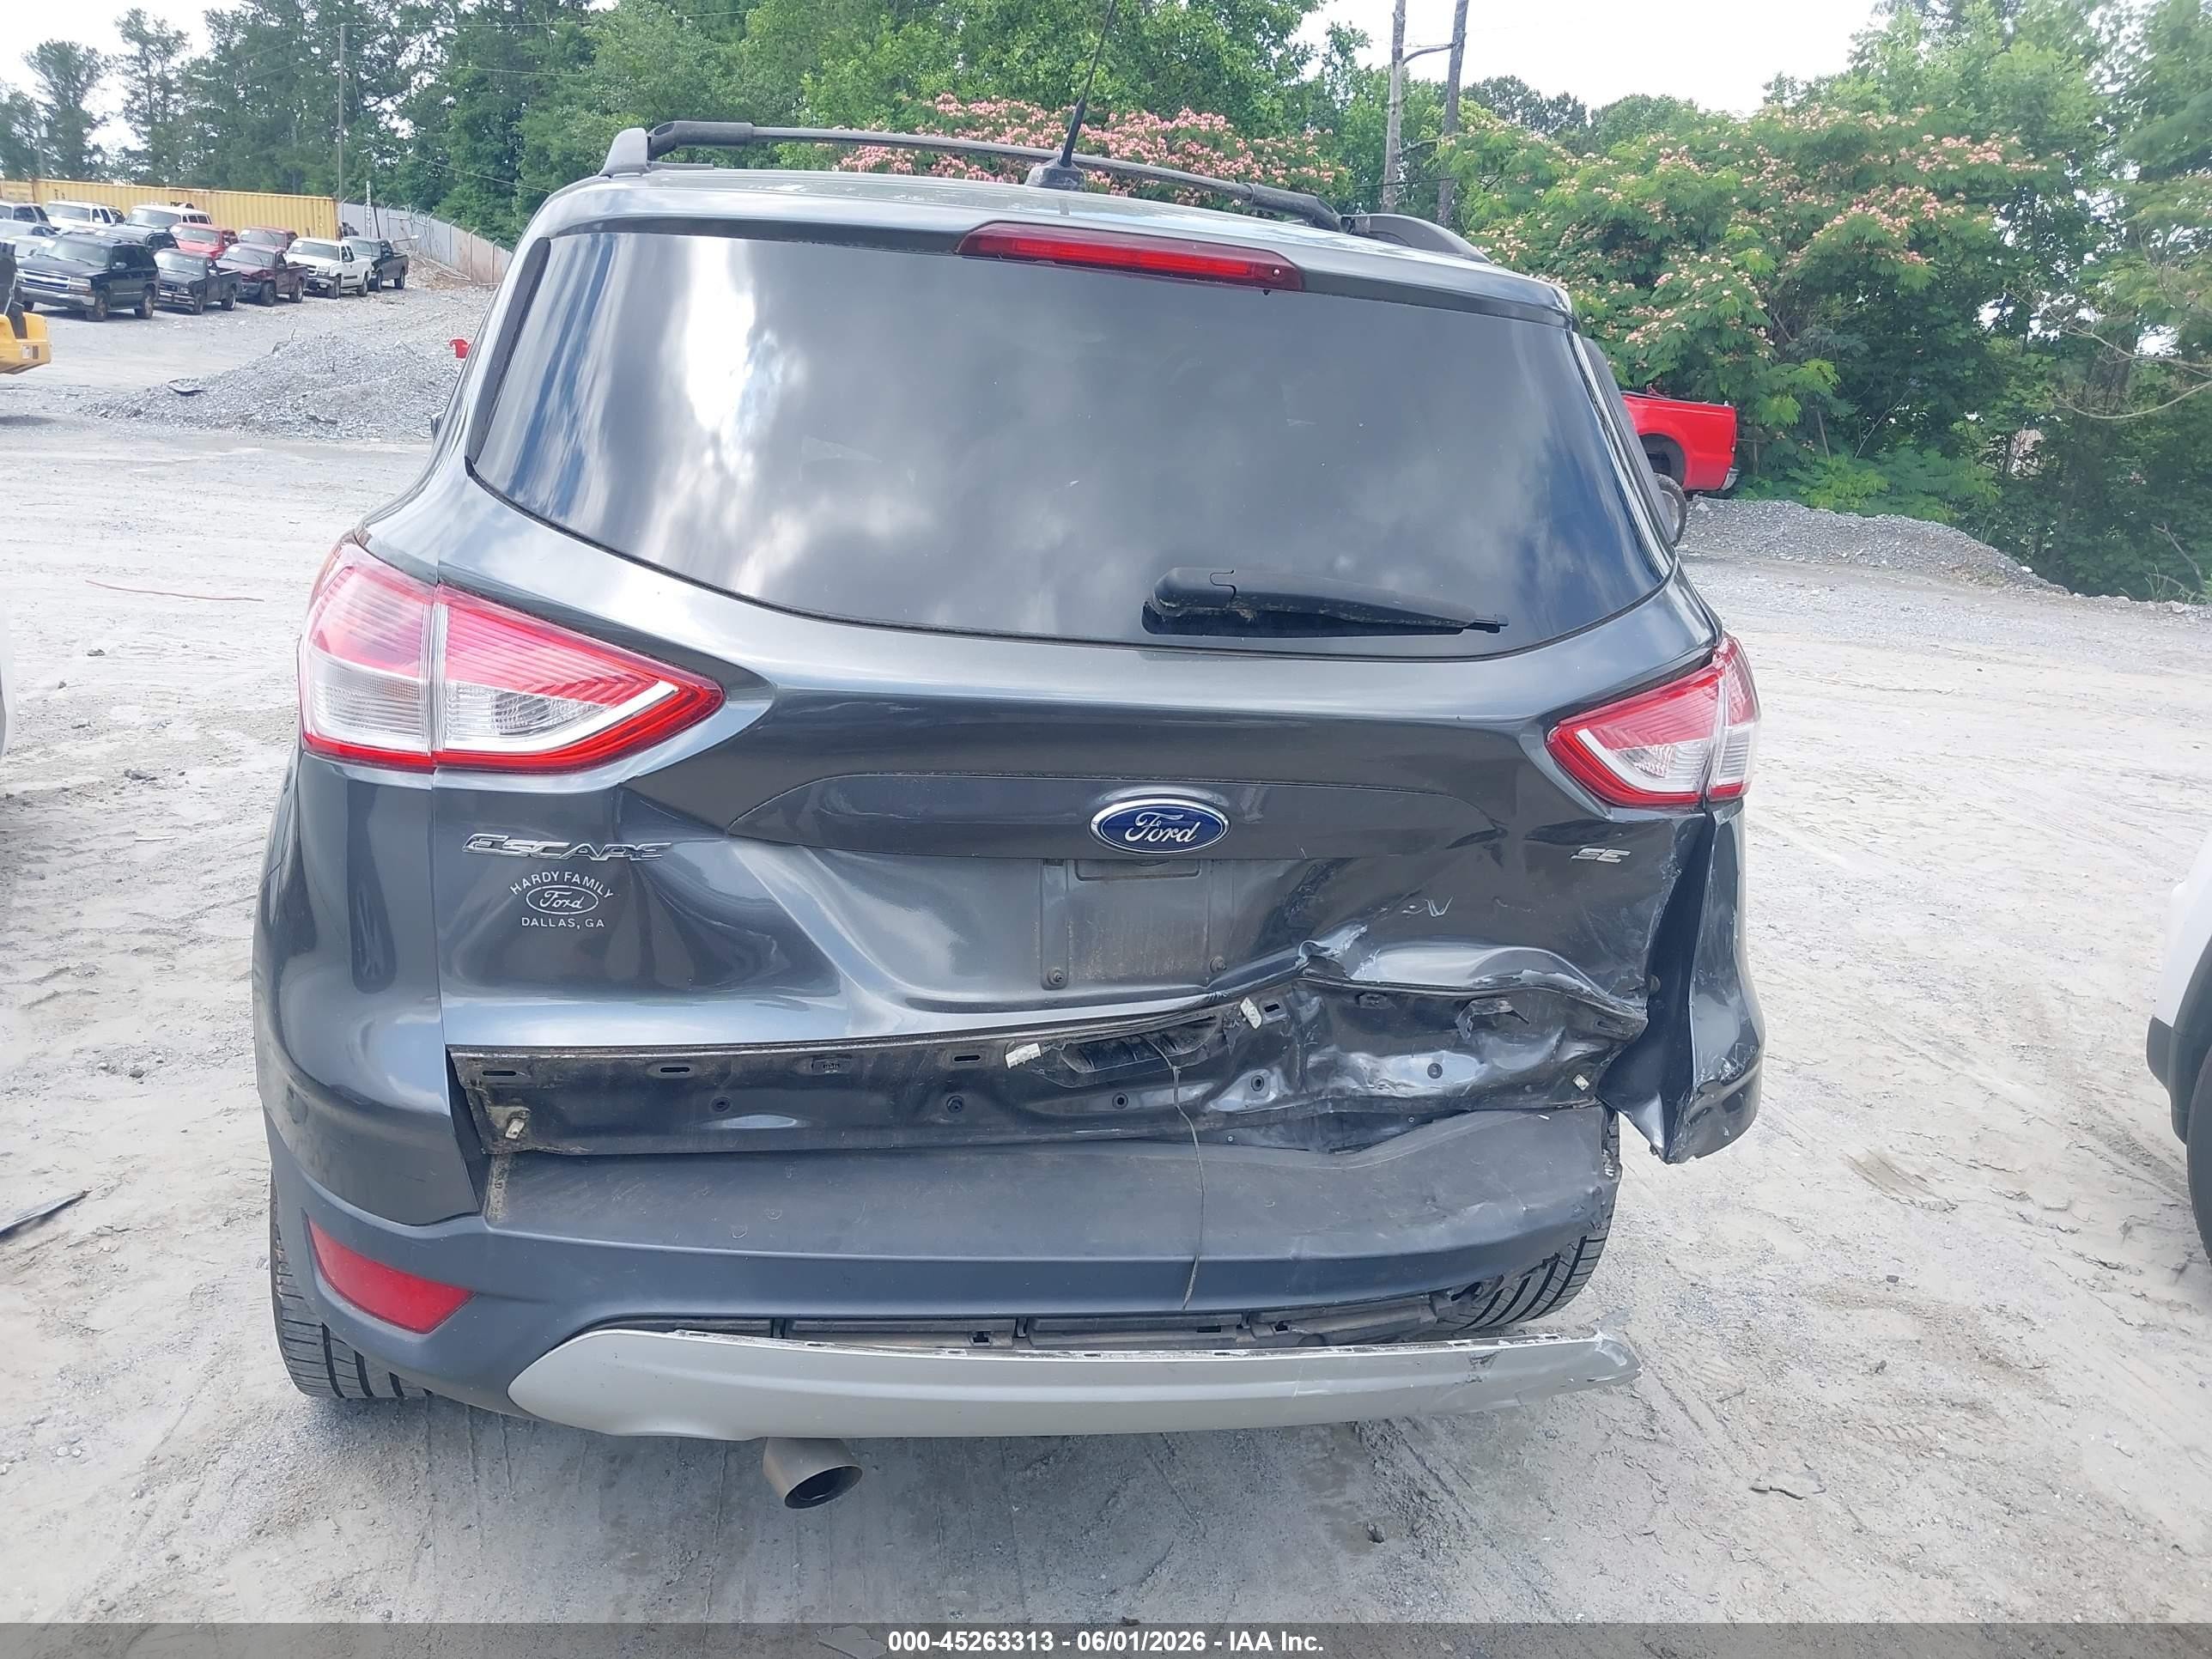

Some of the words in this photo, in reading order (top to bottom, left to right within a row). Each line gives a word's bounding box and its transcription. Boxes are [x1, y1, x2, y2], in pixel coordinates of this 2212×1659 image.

[1125, 811, 1200, 842] Ford
[462, 833, 672, 861] ESCAPE
[1571, 848, 1632, 864] SE
[510, 871, 560, 896] HARDY
[563, 872, 614, 899] FAMILY
[539, 890, 585, 909] Ford
[521, 917, 581, 930] DALLAS,
[585, 918, 605, 928] GA
